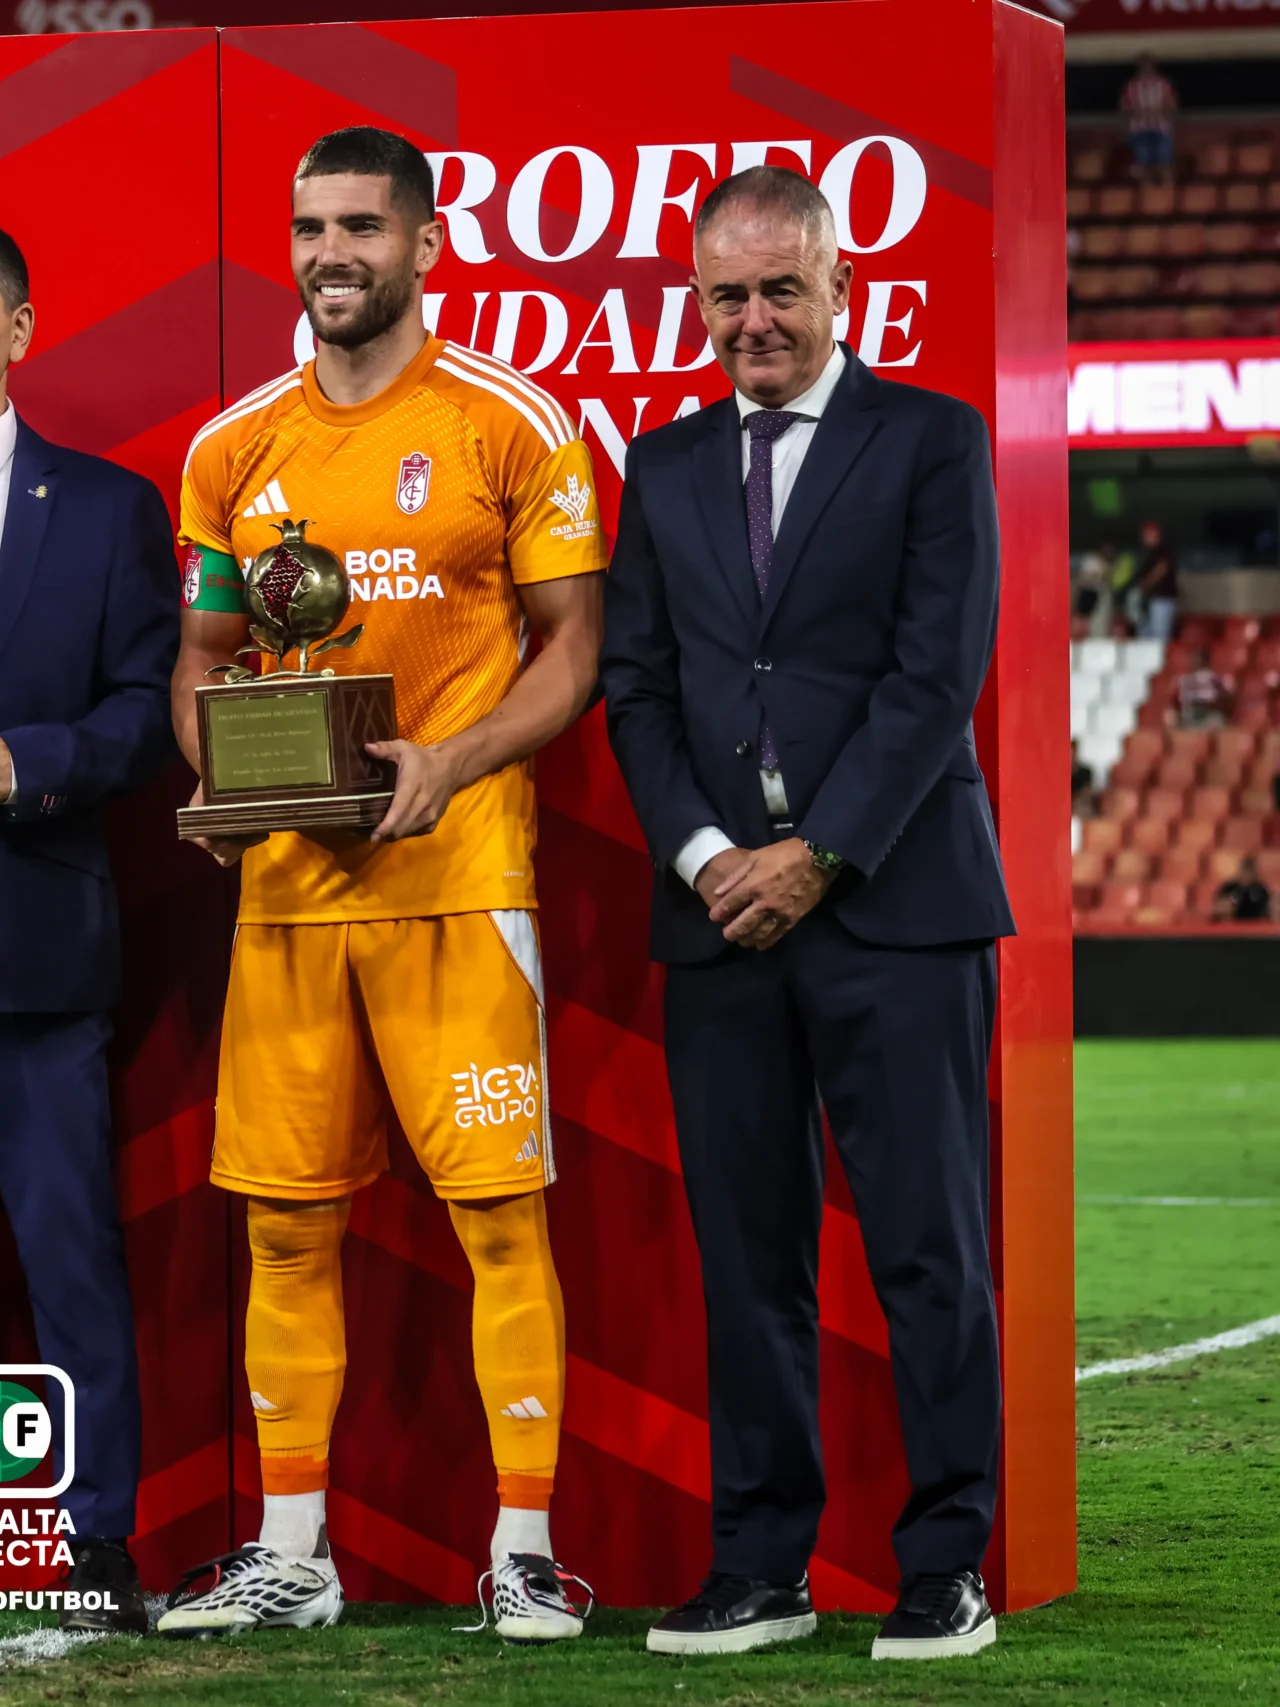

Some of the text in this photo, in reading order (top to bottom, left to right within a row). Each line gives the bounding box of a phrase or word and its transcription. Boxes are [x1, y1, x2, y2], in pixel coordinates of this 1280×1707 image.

[549, 524, 574, 537] CAJA
[563, 529, 594, 541] GRANADA
[454, 1096, 536, 1129] GRUPO
